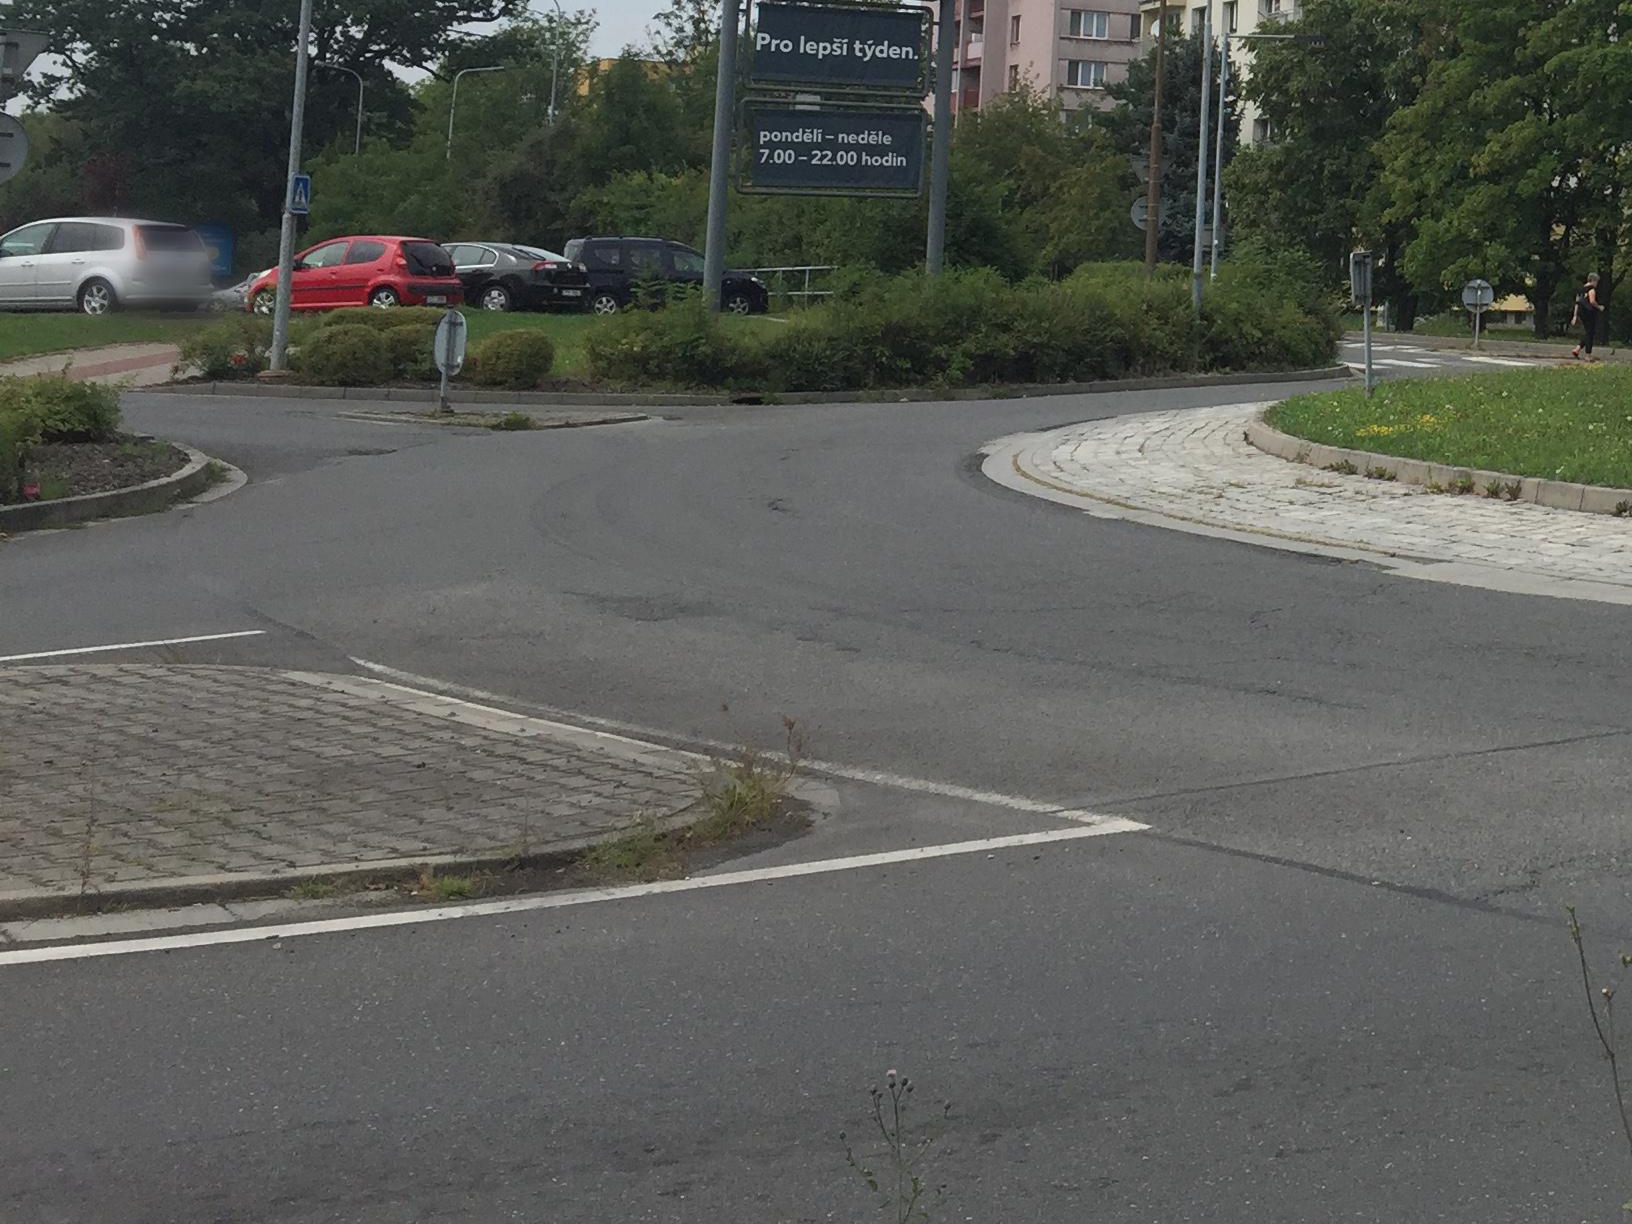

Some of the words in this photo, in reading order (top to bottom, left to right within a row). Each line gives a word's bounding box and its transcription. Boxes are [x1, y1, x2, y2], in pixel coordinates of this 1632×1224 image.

[755, 32, 793, 53] Pro
[799, 35, 849, 59] lepší
[853, 39, 919, 62] týden.
[759, 128, 823, 145] pondělí
[838, 130, 893, 145] neděle
[759, 149, 796, 164] 7.00
[810, 150, 858, 165] 22.00
[861, 152, 907, 167] hodin
